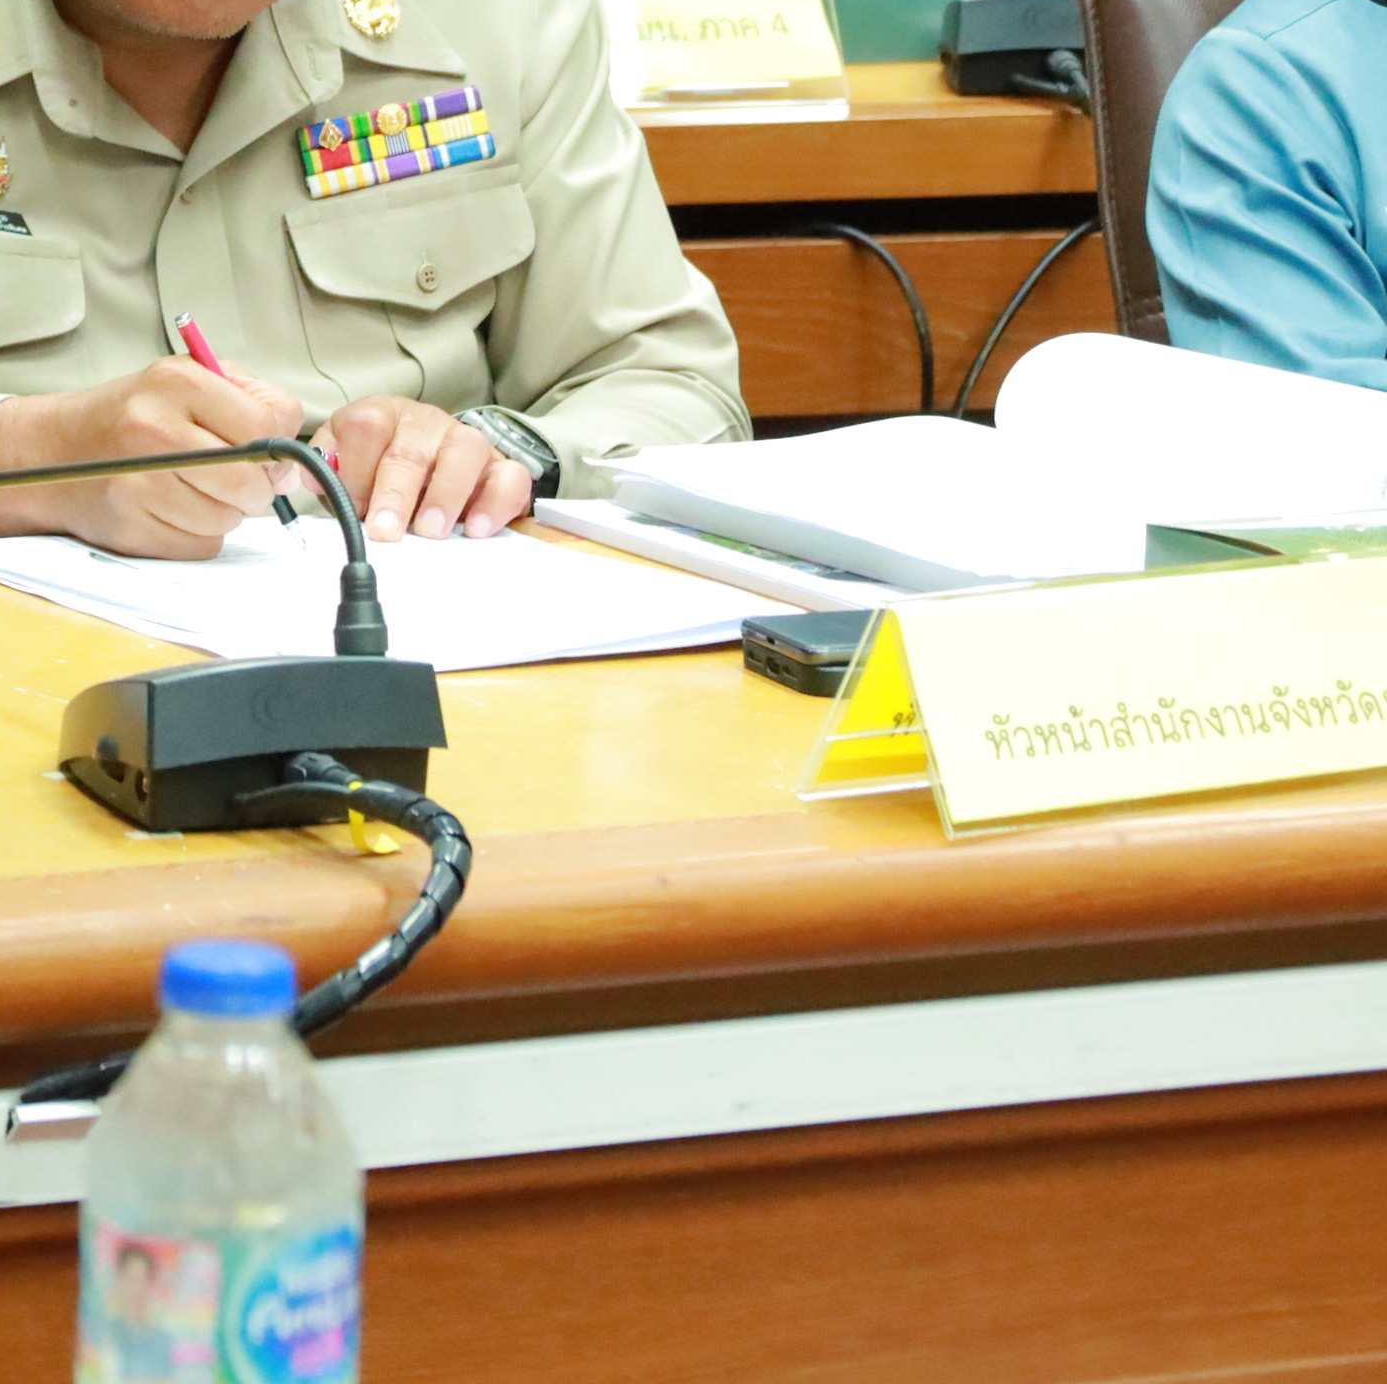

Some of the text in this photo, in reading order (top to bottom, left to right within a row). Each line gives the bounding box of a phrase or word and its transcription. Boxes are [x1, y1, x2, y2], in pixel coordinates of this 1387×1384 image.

[699, 17, 762, 41] ภาค
[772, 12, 789, 35] 4
[984, 678, 1387, 761] หัวหน้าสำนักงานจังหวัด
